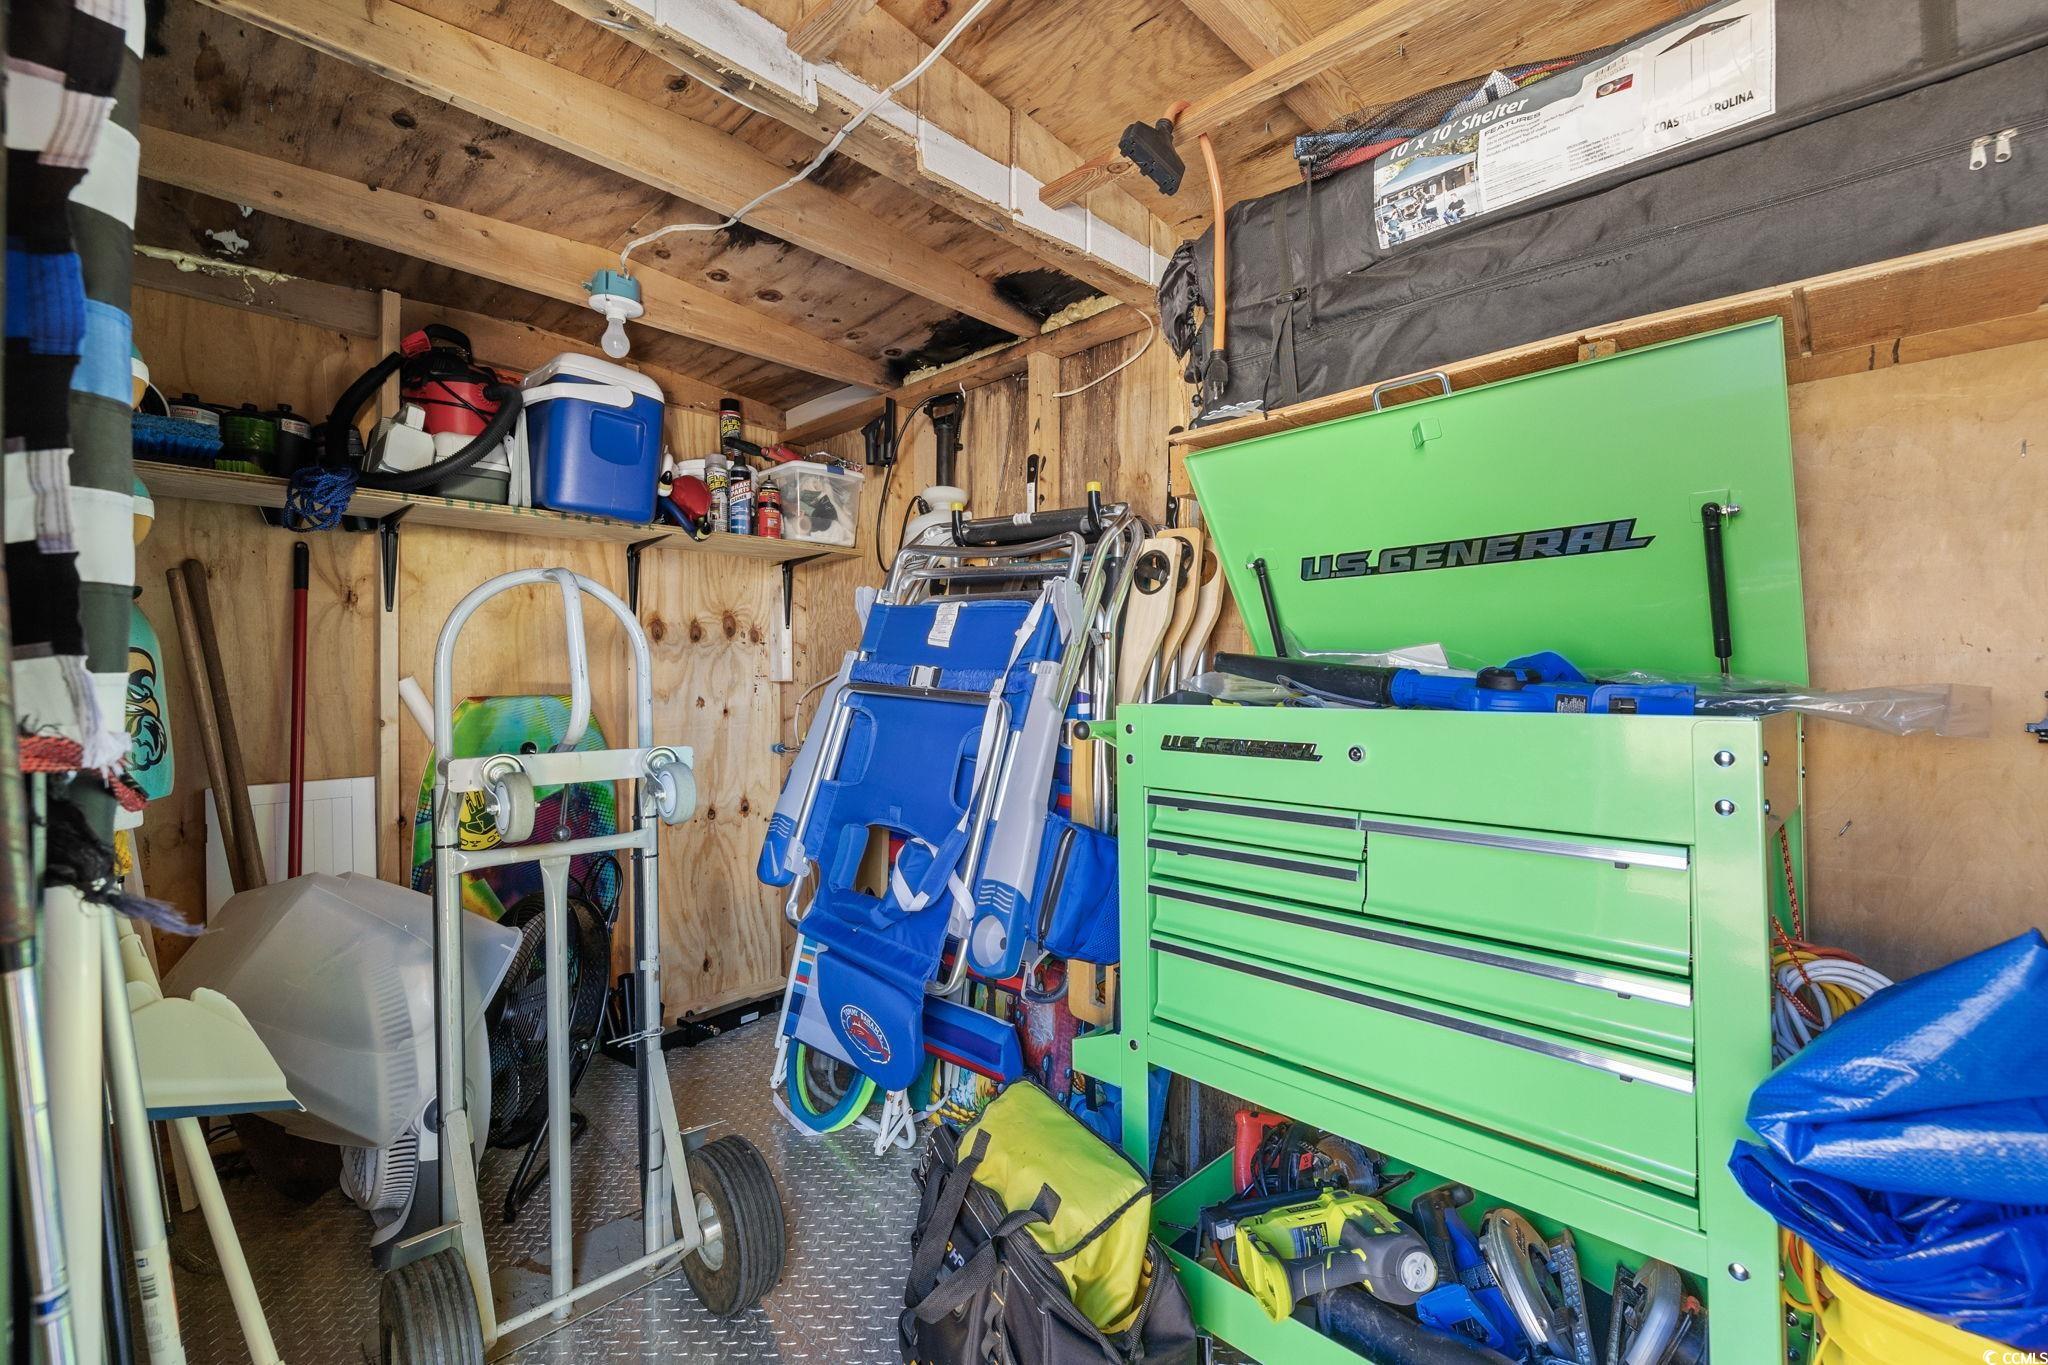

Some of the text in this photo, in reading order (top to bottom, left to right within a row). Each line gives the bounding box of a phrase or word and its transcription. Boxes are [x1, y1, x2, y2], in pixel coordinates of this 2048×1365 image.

[1701, 90, 1754, 117] CAROLINA
[1414, 136, 1428, 150] x
[1459, 98, 1529, 132] Shelter
[1484, 112, 1541, 136] FEATURES
